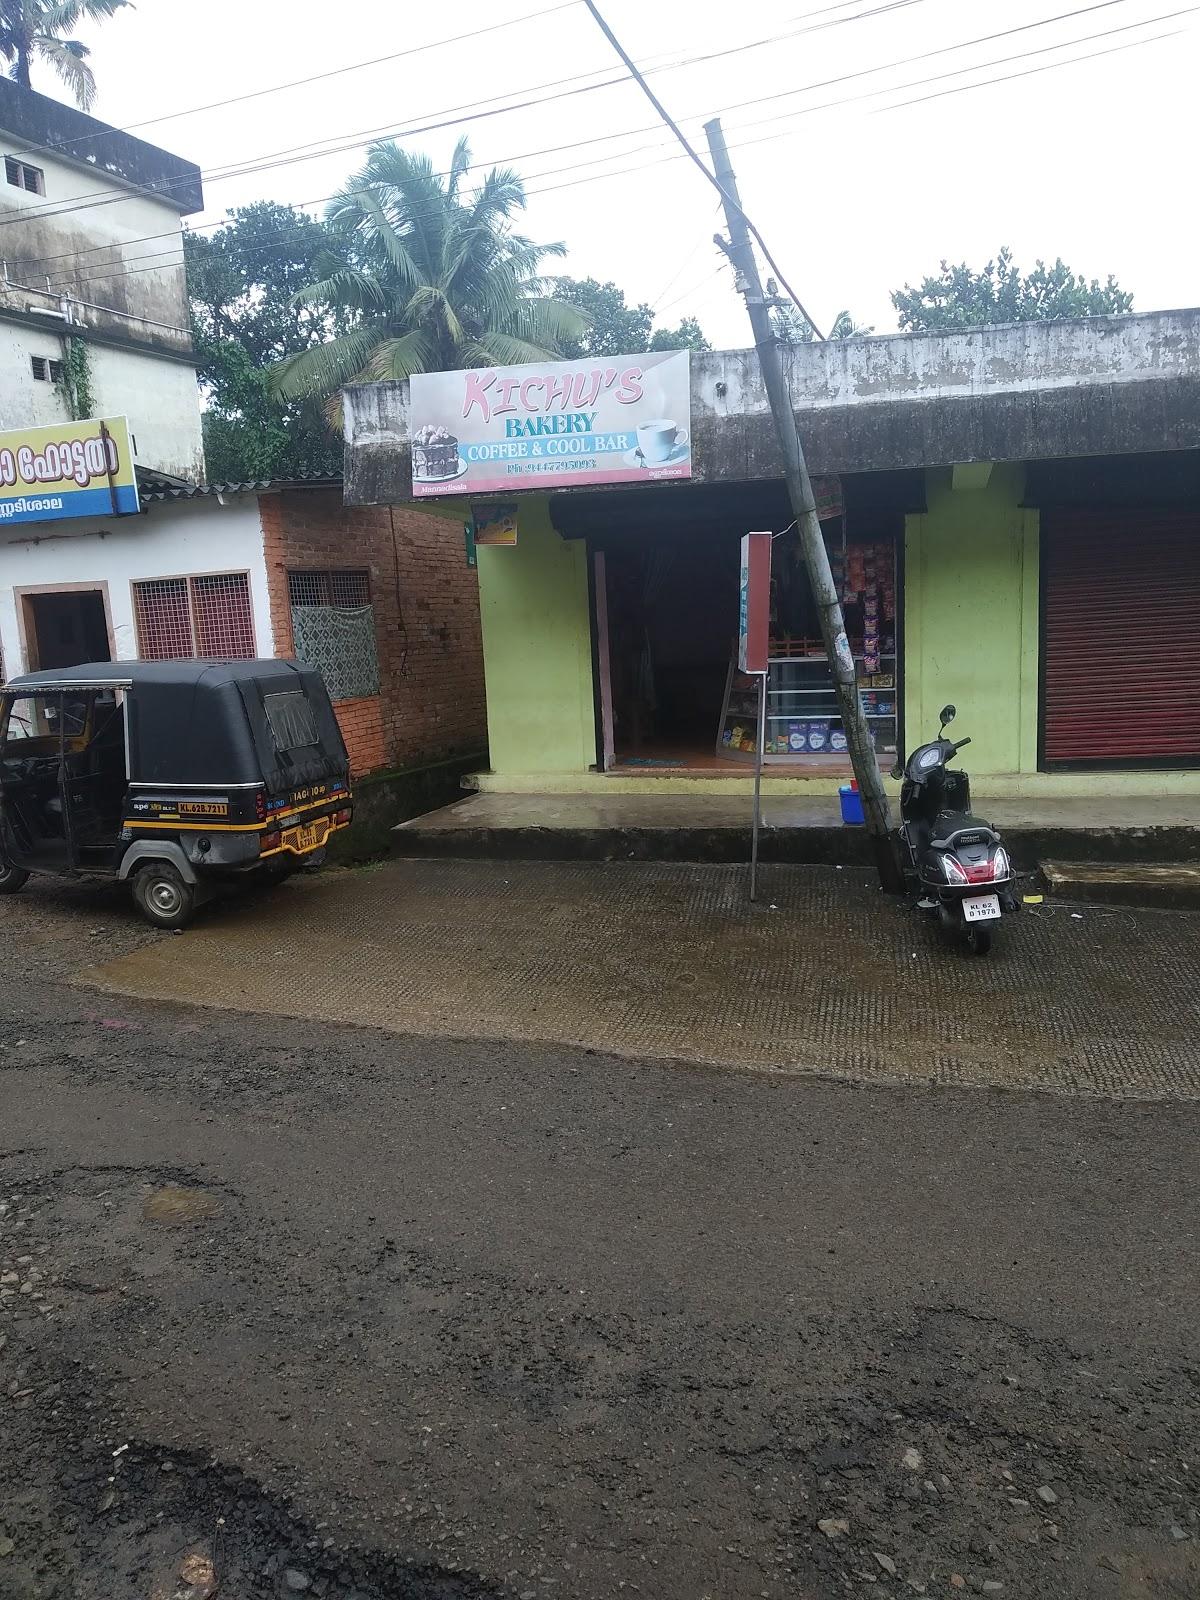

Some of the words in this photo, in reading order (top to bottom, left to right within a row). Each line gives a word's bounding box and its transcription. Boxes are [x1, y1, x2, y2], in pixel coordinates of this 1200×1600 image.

[462, 367, 643, 423] KICHU'S
[505, 412, 597, 438] BAKERY
[468, 442, 528, 461] COFFEE
[531, 442, 542, 456] &
[546, 438, 590, 454] COOL
[594, 435, 629, 450] BAR
[180, 803, 226, 813] KL.62B.7211
